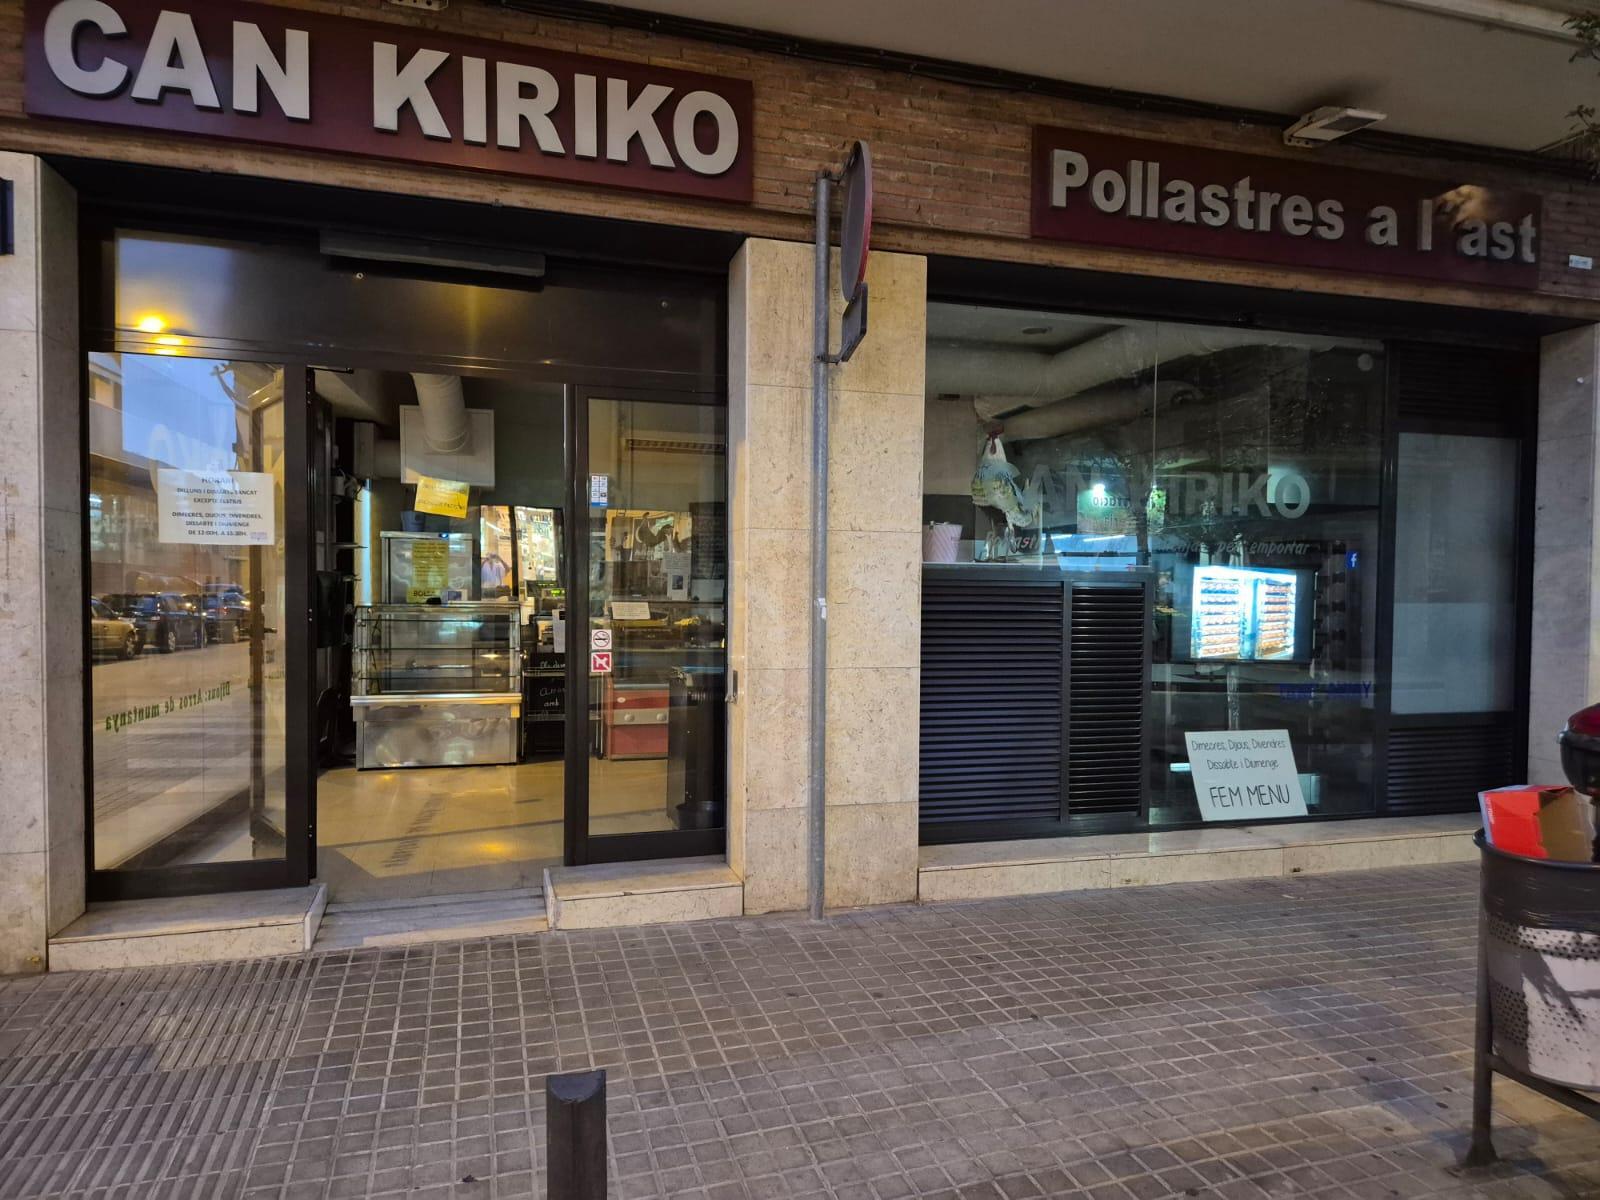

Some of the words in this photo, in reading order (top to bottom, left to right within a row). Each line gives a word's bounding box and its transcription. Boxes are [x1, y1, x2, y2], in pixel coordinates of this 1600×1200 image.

[43, 0, 311, 120] CAN
[373, 41, 740, 175] KIRIKO
[1049, 148, 1345, 240] Pollastres
[1366, 202, 1399, 246] a
[1249, 540, 1311, 557] emportar
[1209, 786, 1244, 808] FEM
[1246, 784, 1291, 807] MENU
